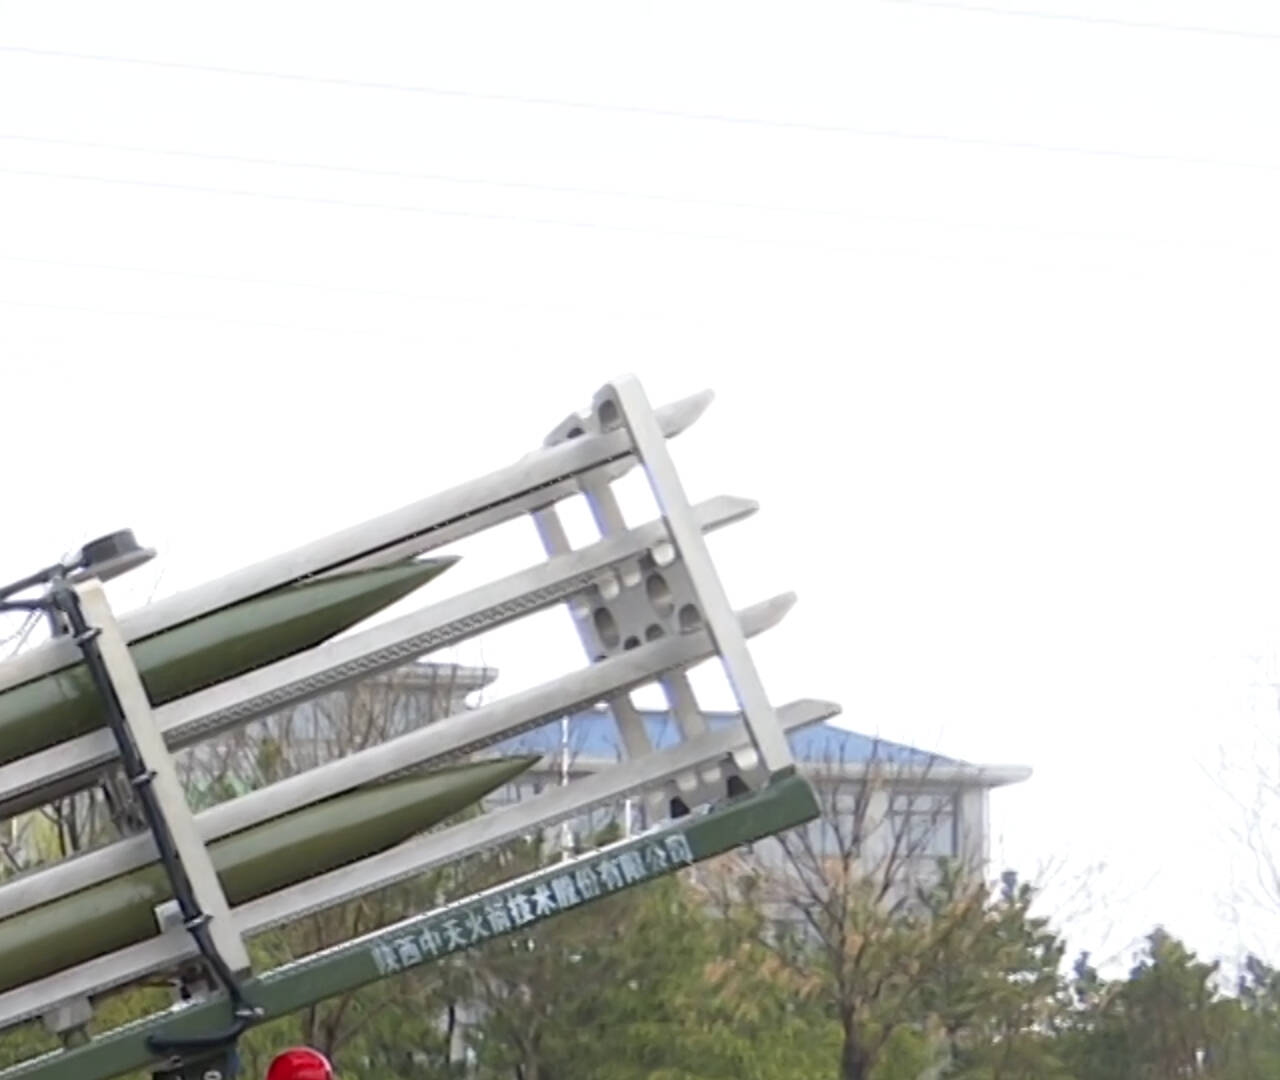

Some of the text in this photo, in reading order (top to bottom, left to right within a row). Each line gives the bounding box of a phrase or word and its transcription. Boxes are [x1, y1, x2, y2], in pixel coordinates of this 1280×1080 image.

[371, 833, 694, 975] 陕西中天火箭技术股份有限公司
